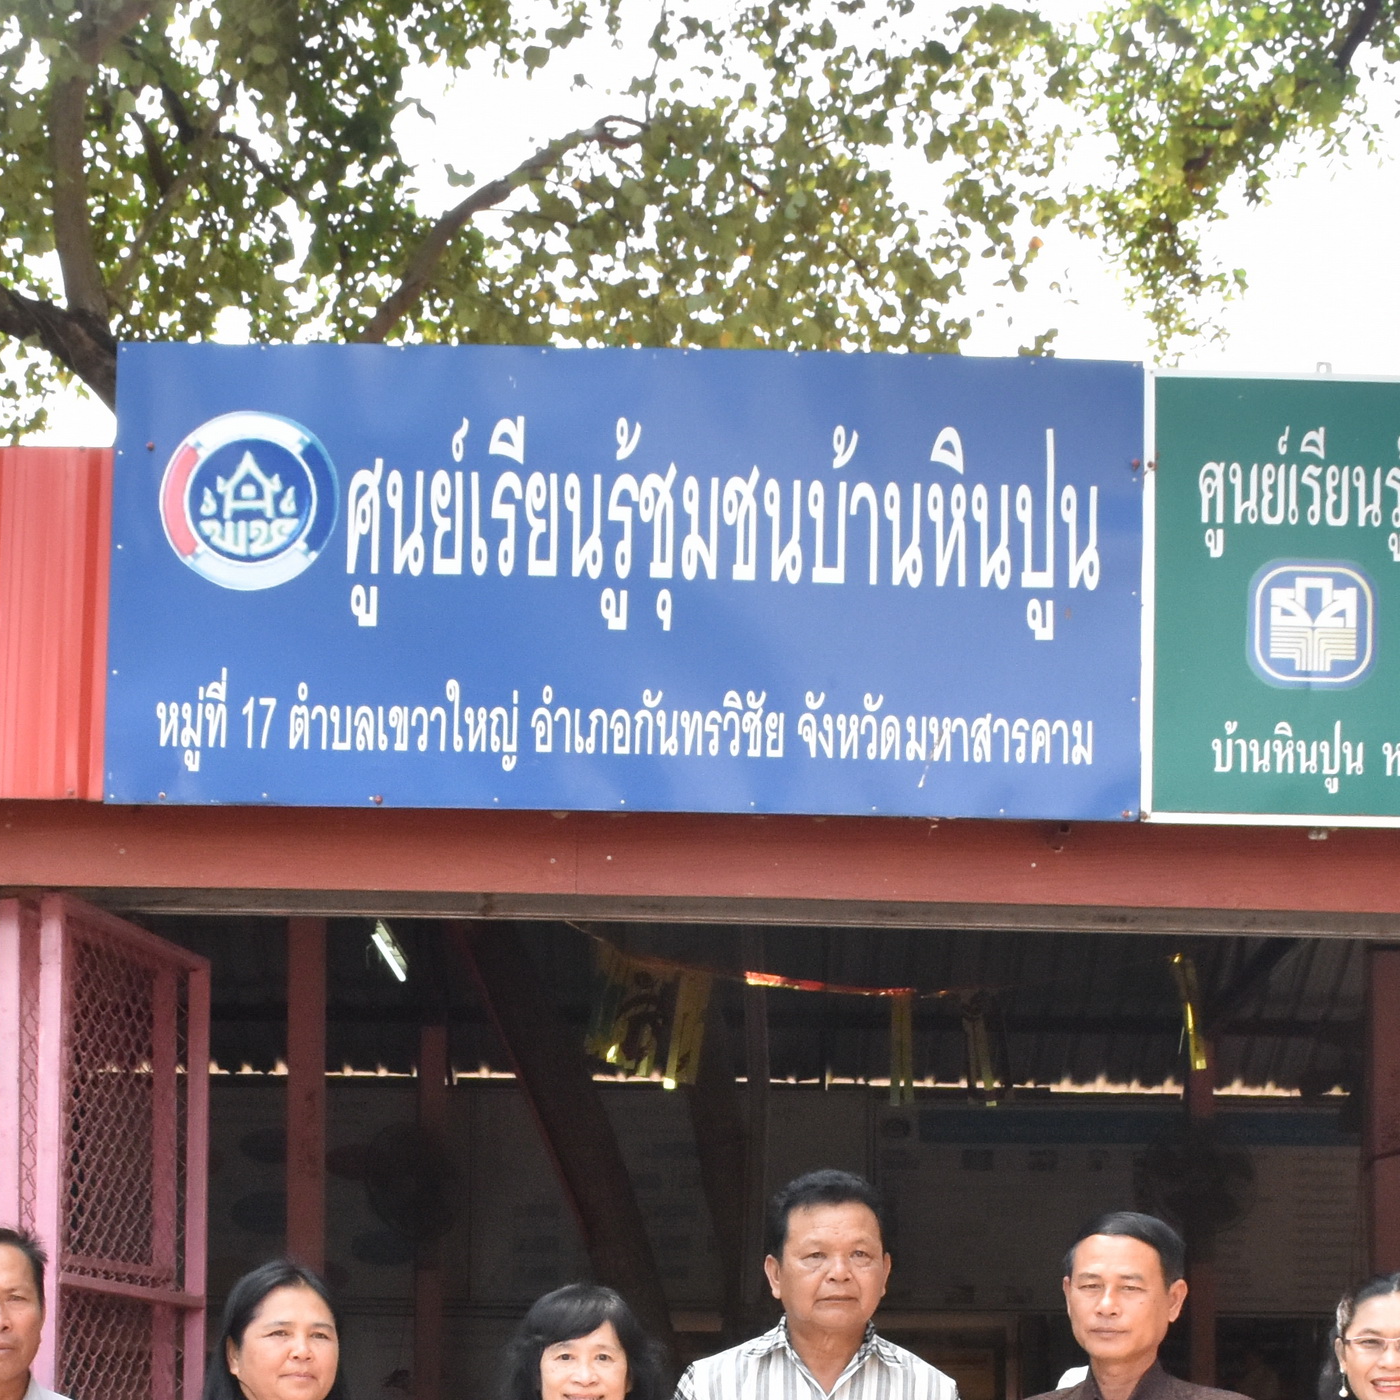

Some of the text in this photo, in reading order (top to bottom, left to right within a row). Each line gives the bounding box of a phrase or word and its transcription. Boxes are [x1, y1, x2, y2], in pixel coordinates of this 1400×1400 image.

[345, 415, 1102, 641] ศูนย์เรียนรู้ชุมชนบ้านหินปูน
[156, 667, 1095, 772] หมู่ที่ 17 ตำบลเขวาใหญ่ อำเภอกันทรวิชัย จังหวัดมหาสารคาม
[1211, 720, 1365, 795] บ้านหินปูน
